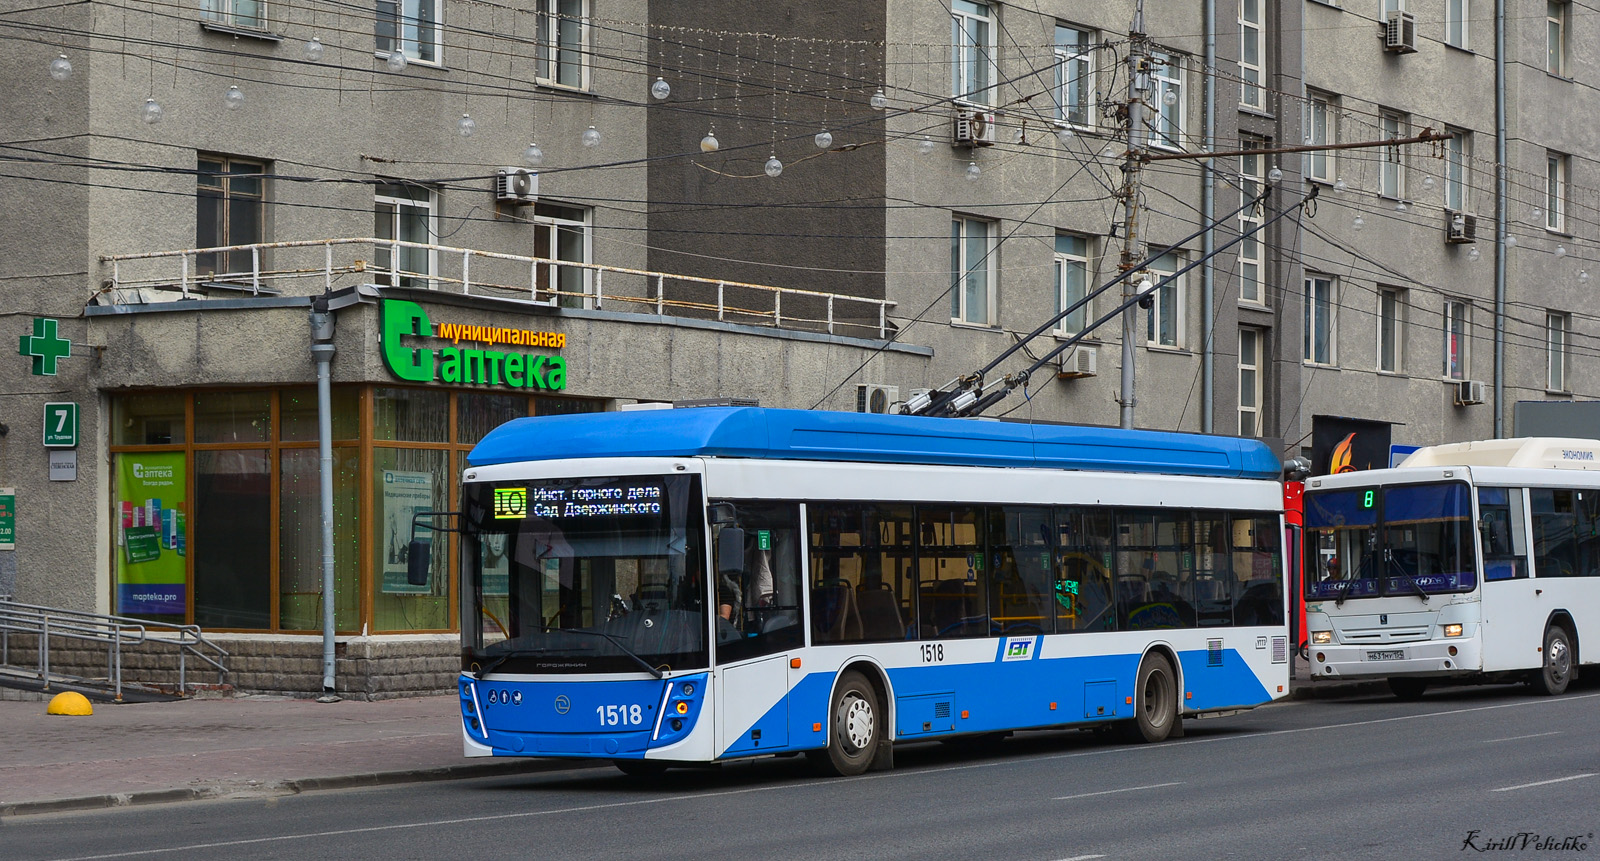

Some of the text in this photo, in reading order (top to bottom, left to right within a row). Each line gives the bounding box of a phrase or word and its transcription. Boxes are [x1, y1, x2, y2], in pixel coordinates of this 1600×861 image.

[438, 322, 566, 348] муниципальная
[438, 346, 567, 391] аптека
[55, 409, 67, 432] 7
[145, 469, 173, 478] аптека
[496, 491, 523, 515] 10
[534, 487, 660, 501] Инст. горного дела
[1365, 490, 1374, 507] 8
[534, 502, 661, 517] Сад Дзержинского
[133, 592, 177, 602] mapteka.pro
[920, 643, 944, 663] 1518
[596, 704, 642, 726] 1518
